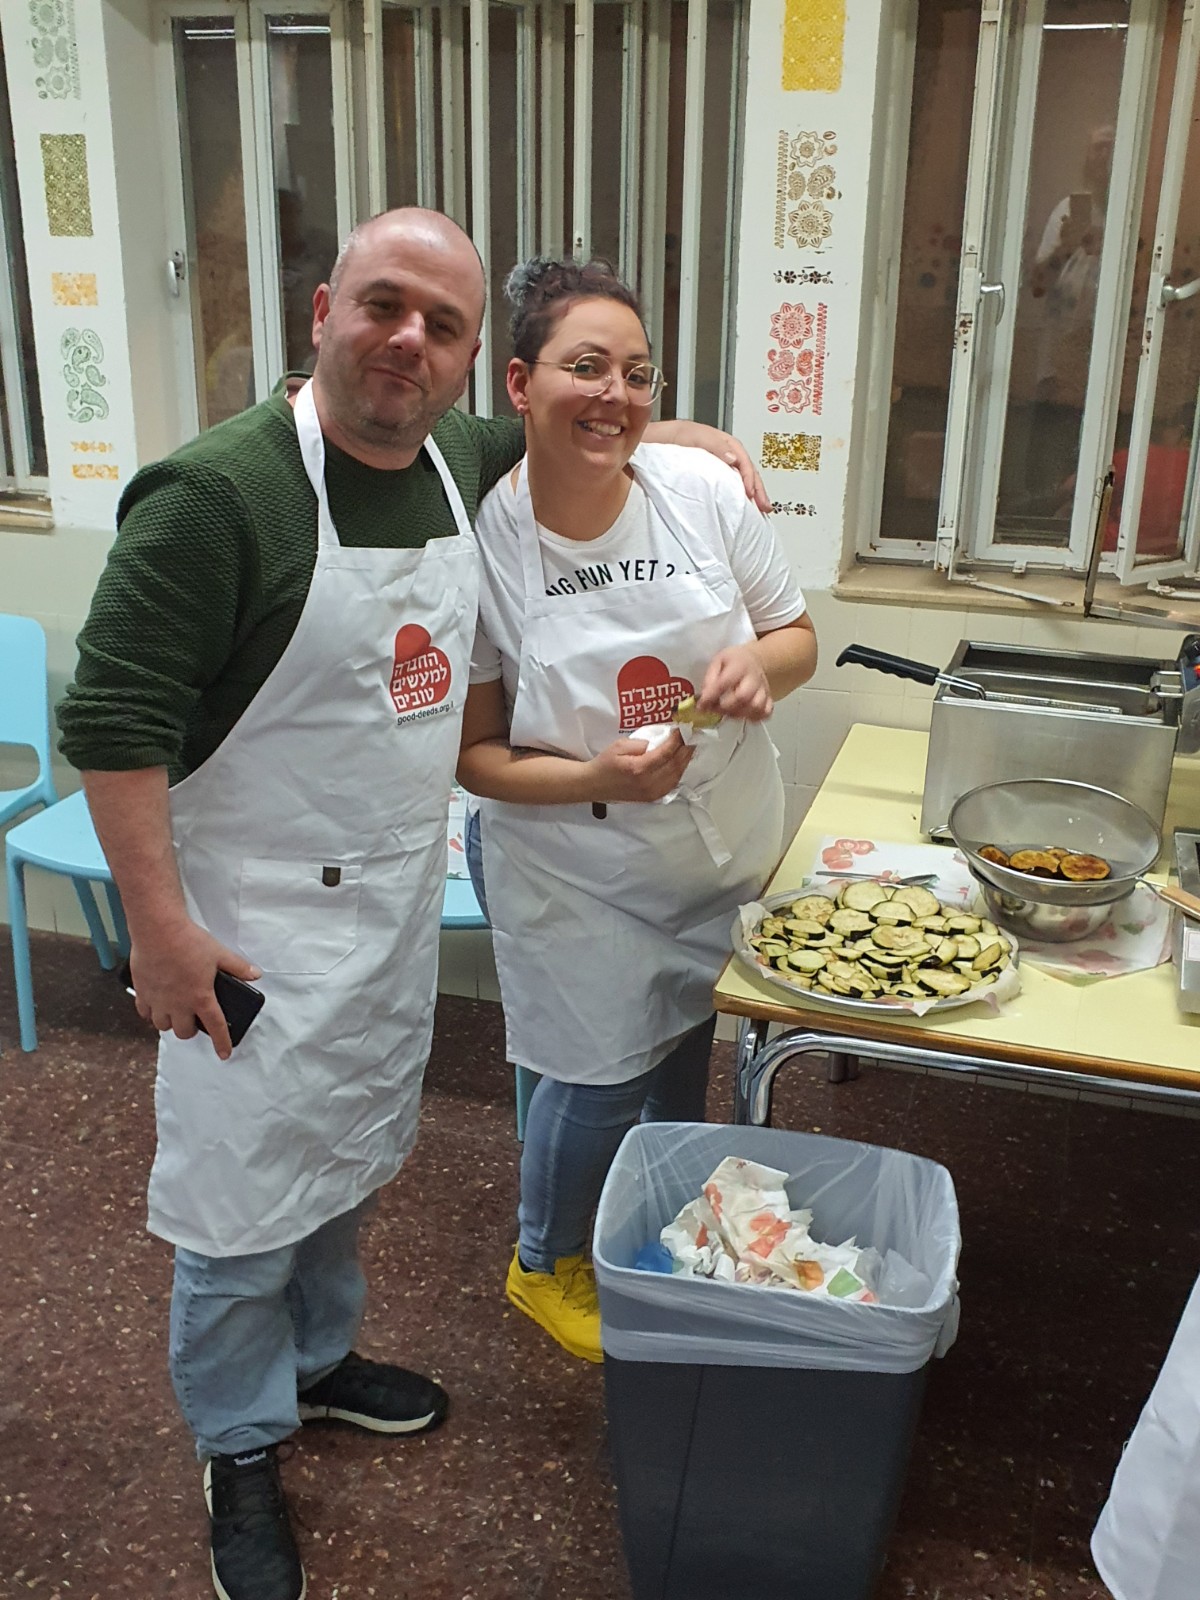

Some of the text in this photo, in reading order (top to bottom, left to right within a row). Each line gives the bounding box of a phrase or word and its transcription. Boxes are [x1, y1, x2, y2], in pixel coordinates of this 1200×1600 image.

[574, 563, 614, 590] FUN
[618, 559, 659, 582] YET
[391, 663, 448, 693] למעשים
[393, 687, 435, 710] טובים
[622, 710, 672, 728] טובים
